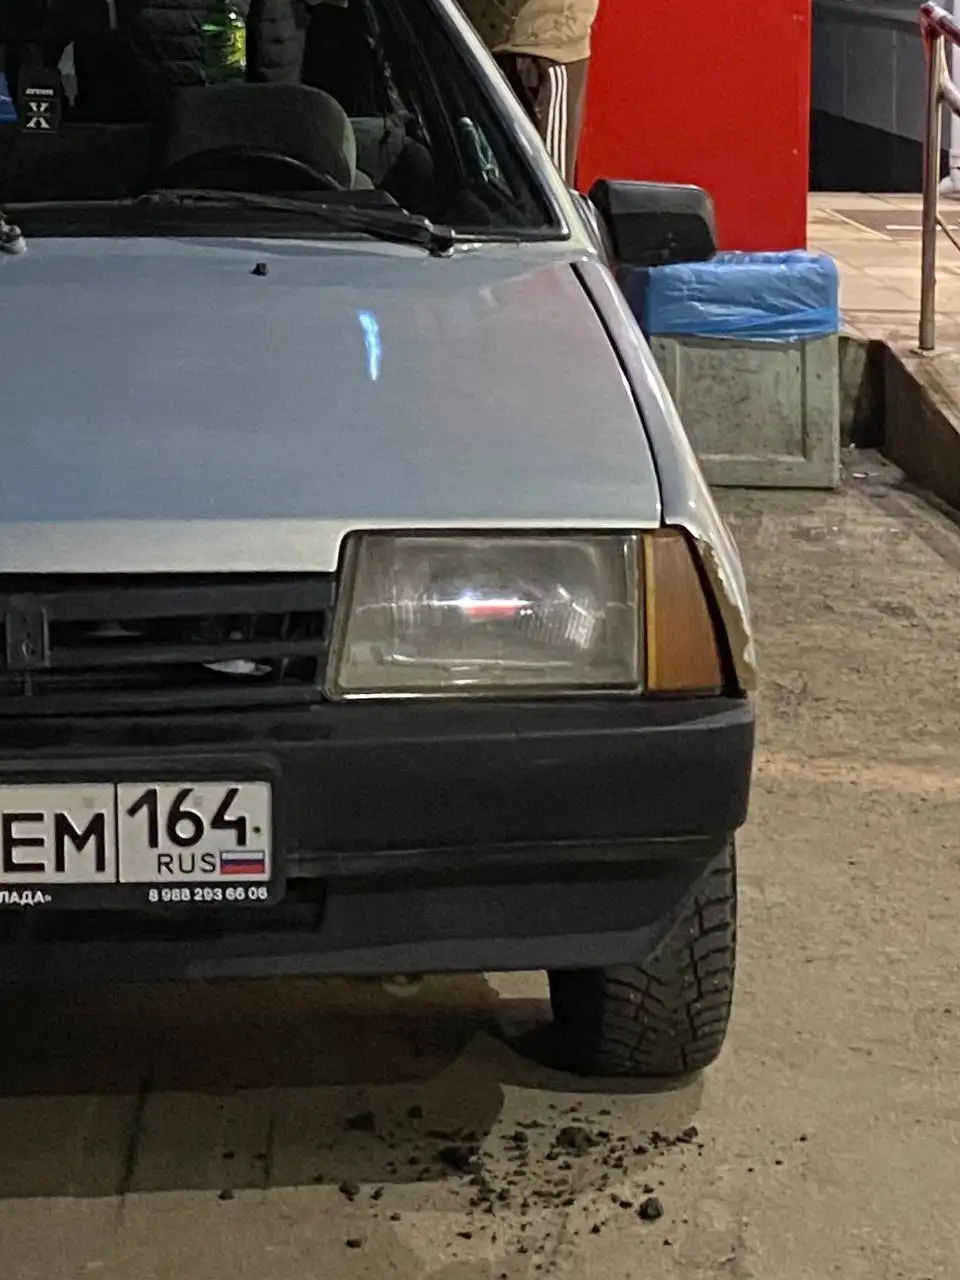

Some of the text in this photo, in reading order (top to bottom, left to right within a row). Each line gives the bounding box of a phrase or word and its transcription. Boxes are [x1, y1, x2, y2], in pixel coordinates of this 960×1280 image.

[126, 787, 247, 849] 164
[157, 852, 217, 875] RUS
[148, 888, 159, 902] 8
